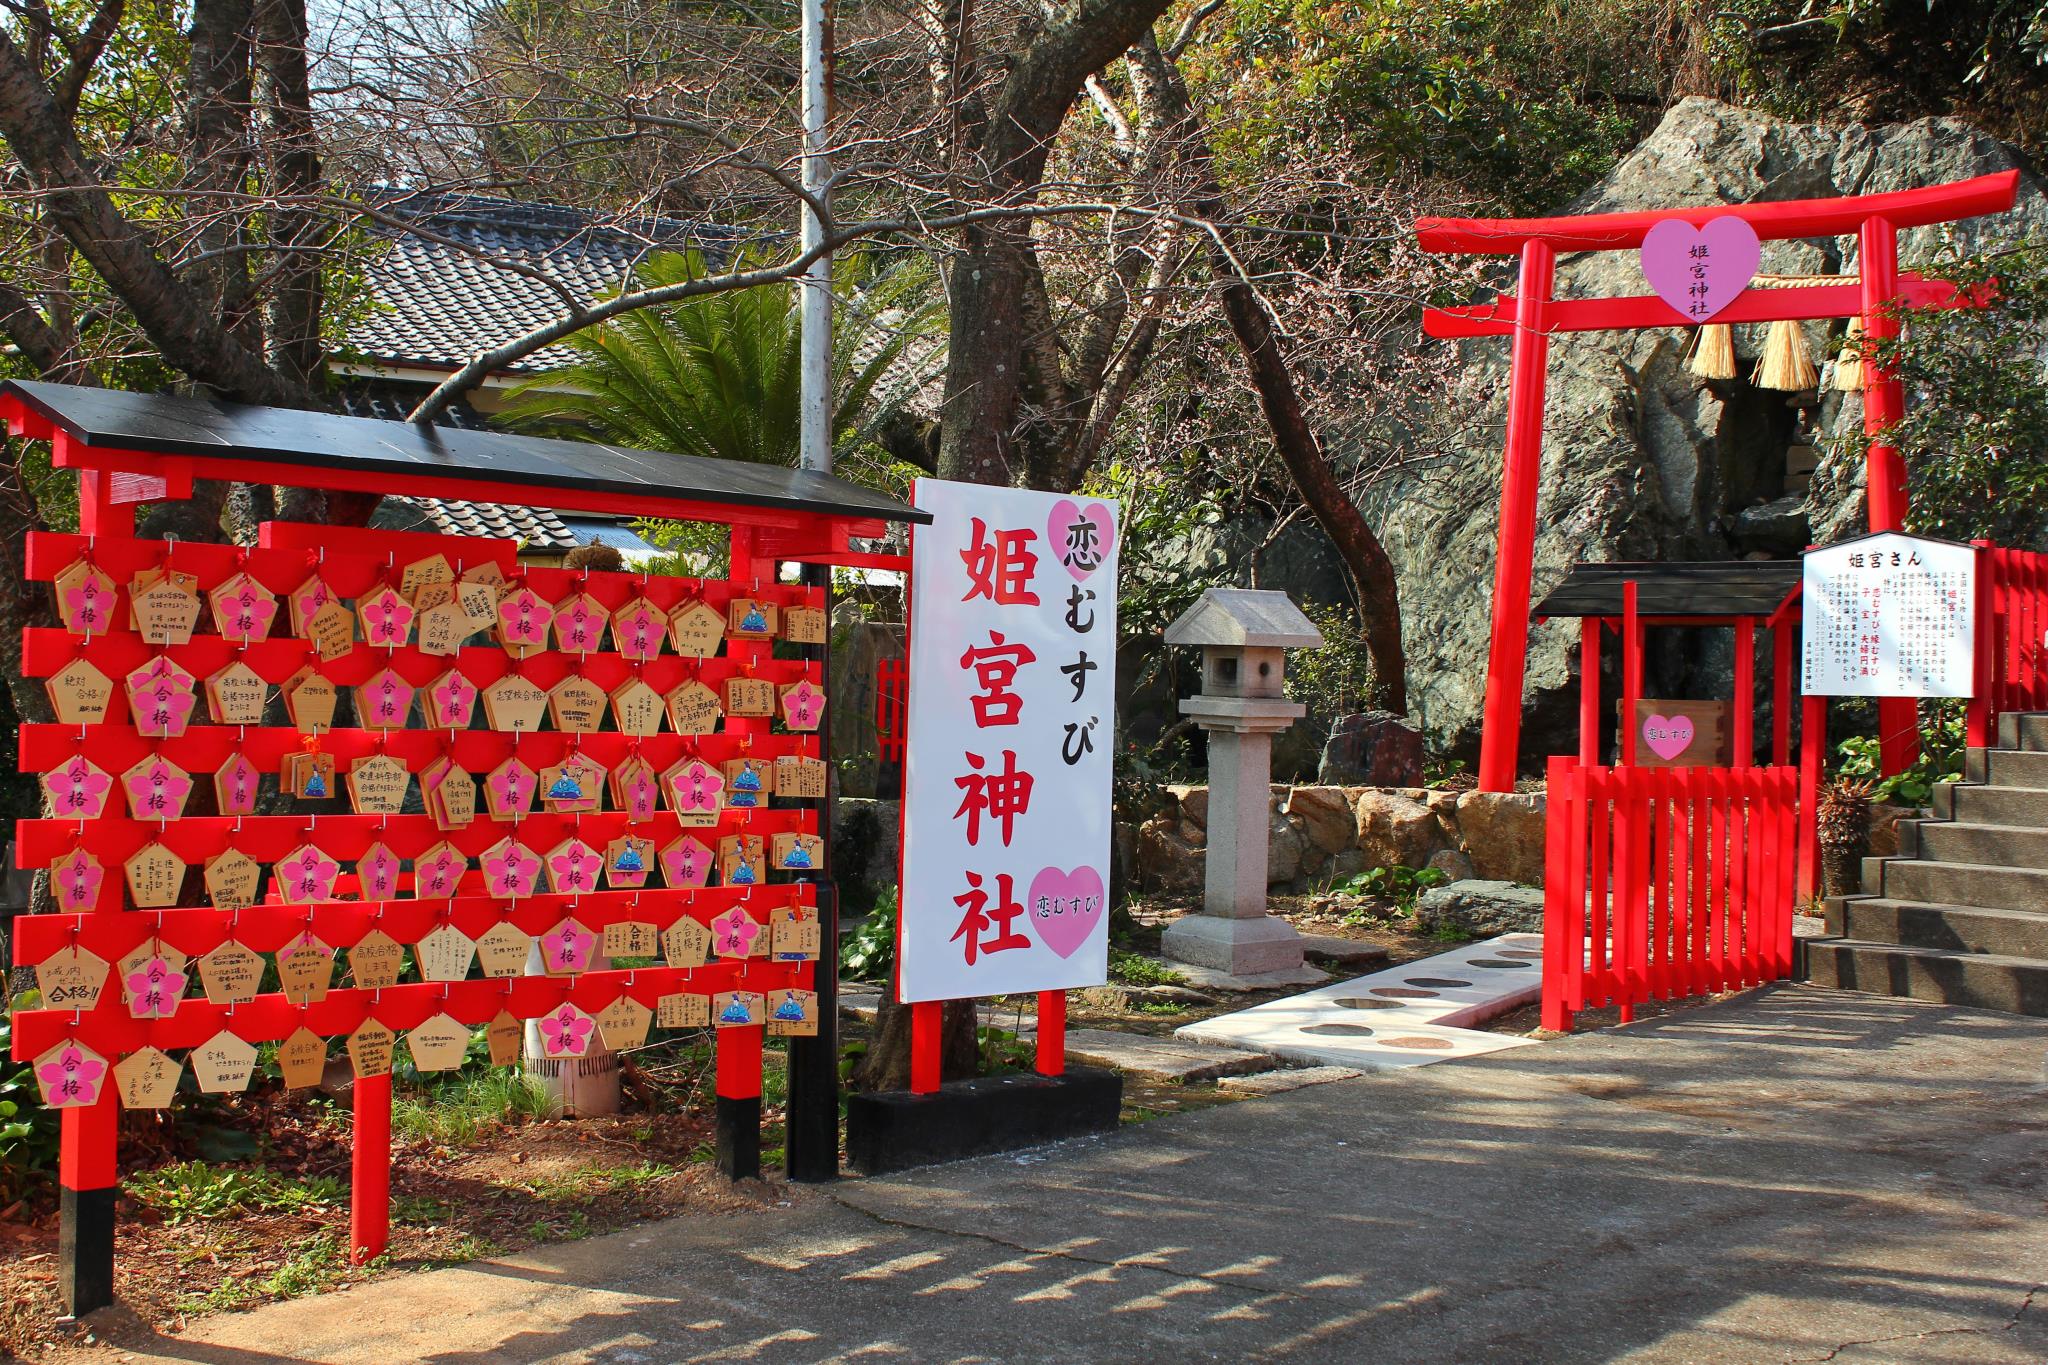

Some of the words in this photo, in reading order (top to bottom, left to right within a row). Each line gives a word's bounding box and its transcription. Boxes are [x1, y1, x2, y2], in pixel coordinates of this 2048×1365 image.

[1688, 245, 1710, 316] 姫宮神社
[1848, 551, 1922, 569] 姫宮さん
[81, 584, 98, 624] 合格
[237, 592, 256, 631] 合格
[380, 601, 396, 636] 合格
[430, 613, 450, 627] 高校
[517, 599, 534, 635] 合格
[571, 611, 587, 644] 合格
[634, 618, 648, 650] 合格
[1060, 515, 1101, 766] 恋むすび
[152, 687, 172, 726] 合格
[380, 681, 396, 717] 合格
[448, 682, 463, 717] 合格
[796, 690, 810, 721] 合格
[950, 517, 1040, 967] 姫宮神社
[1648, 728, 1691, 740] 恋むすび
[68, 767, 88, 807] 合格
[148, 771, 168, 810] 合格
[235, 768, 247, 803] 合格
[506, 769, 520, 805] 合格
[637, 779, 647, 812] 合格
[691, 771, 706, 804] 合格
[300, 855, 318, 893] 合格
[375, 855, 387, 890] 合格
[430, 857, 449, 890] 合格
[503, 854, 521, 888] 合格
[568, 850, 584, 885] 合格
[680, 846, 696, 878] 合格
[72, 861, 88, 900] 合格
[1037, 896, 1099, 917] 恋むすび
[560, 928, 577, 963] 合格
[629, 924, 642, 951] 合格
[726, 915, 743, 948] 合格
[356, 944, 399, 959] 高校合格
[146, 967, 165, 1006] 合格
[559, 1012, 575, 1047] 合格
[207, 1051, 226, 1060] 合格
[62, 1056, 82, 1096] 合格
